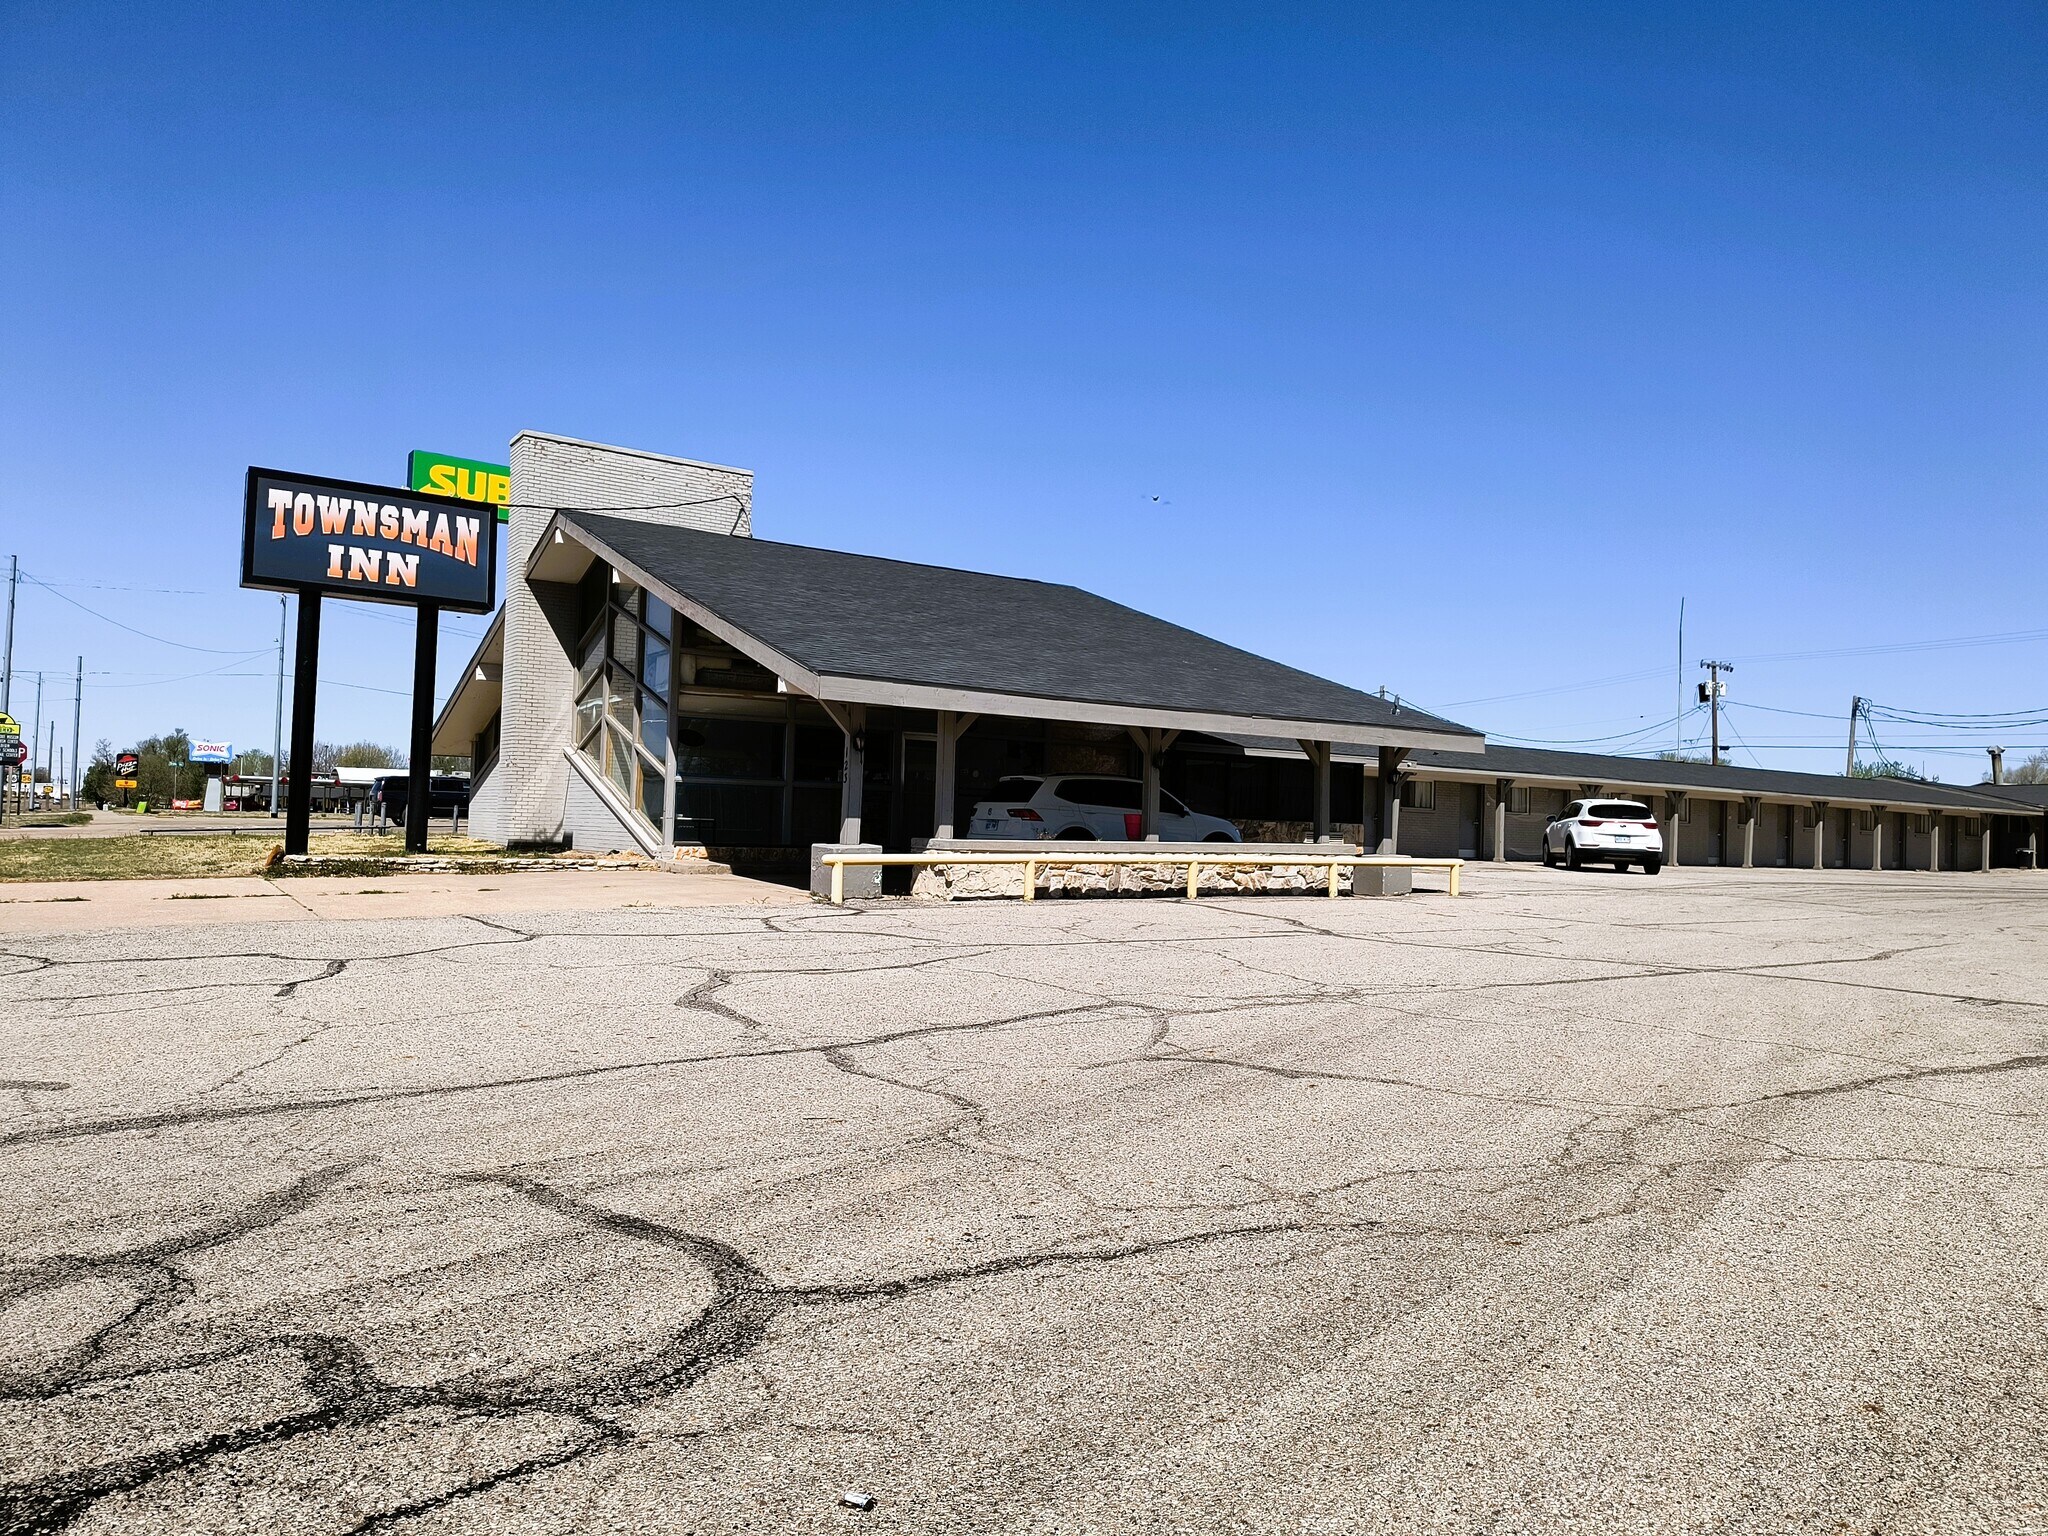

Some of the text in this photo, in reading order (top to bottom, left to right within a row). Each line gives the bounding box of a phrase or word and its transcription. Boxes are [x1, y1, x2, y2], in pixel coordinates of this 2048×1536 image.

[268, 488, 480, 567] TOWNSMAN
[327, 544, 420, 587] INN
[196, 744, 225, 752] SONIC
[116, 761, 138, 772] Pizza
